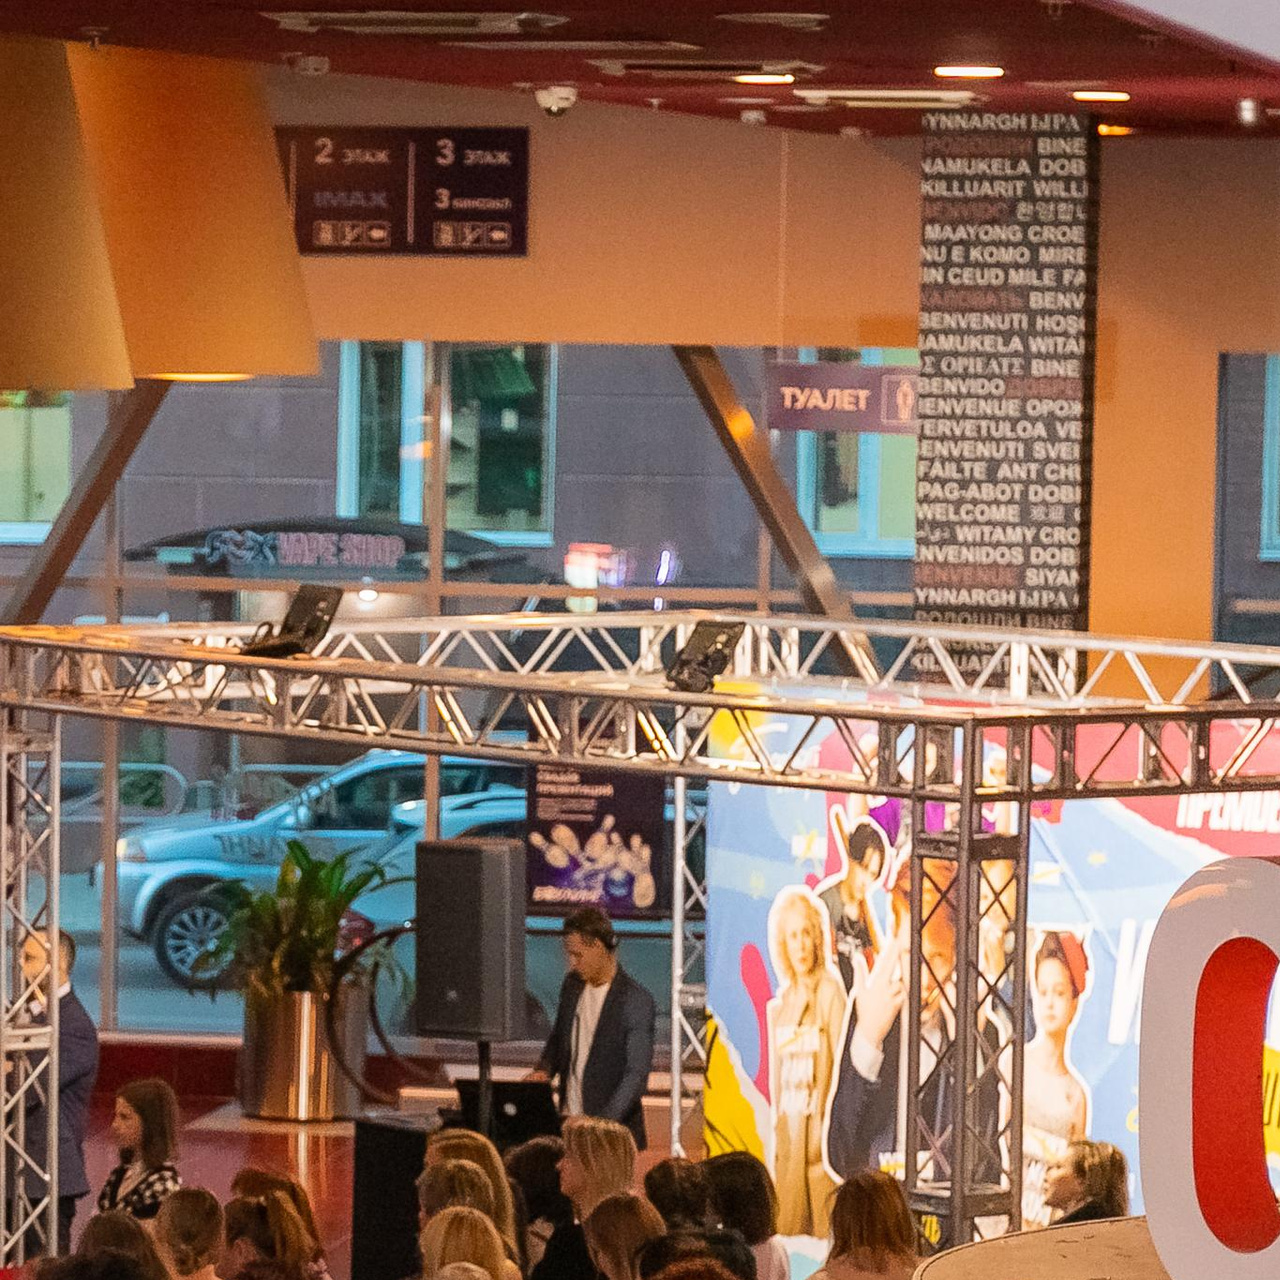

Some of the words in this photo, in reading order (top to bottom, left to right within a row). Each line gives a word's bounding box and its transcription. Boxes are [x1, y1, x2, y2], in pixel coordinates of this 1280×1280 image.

[314, 137, 334, 164] 2
[436, 138, 455, 166] 3
[435, 188, 450, 209] 3
[780, 386, 869, 411] ТУАЛЕТ
[916, 502, 1020, 521] WELCOME
[278, 532, 339, 566] VAPE
[340, 533, 405, 567] SHOP
